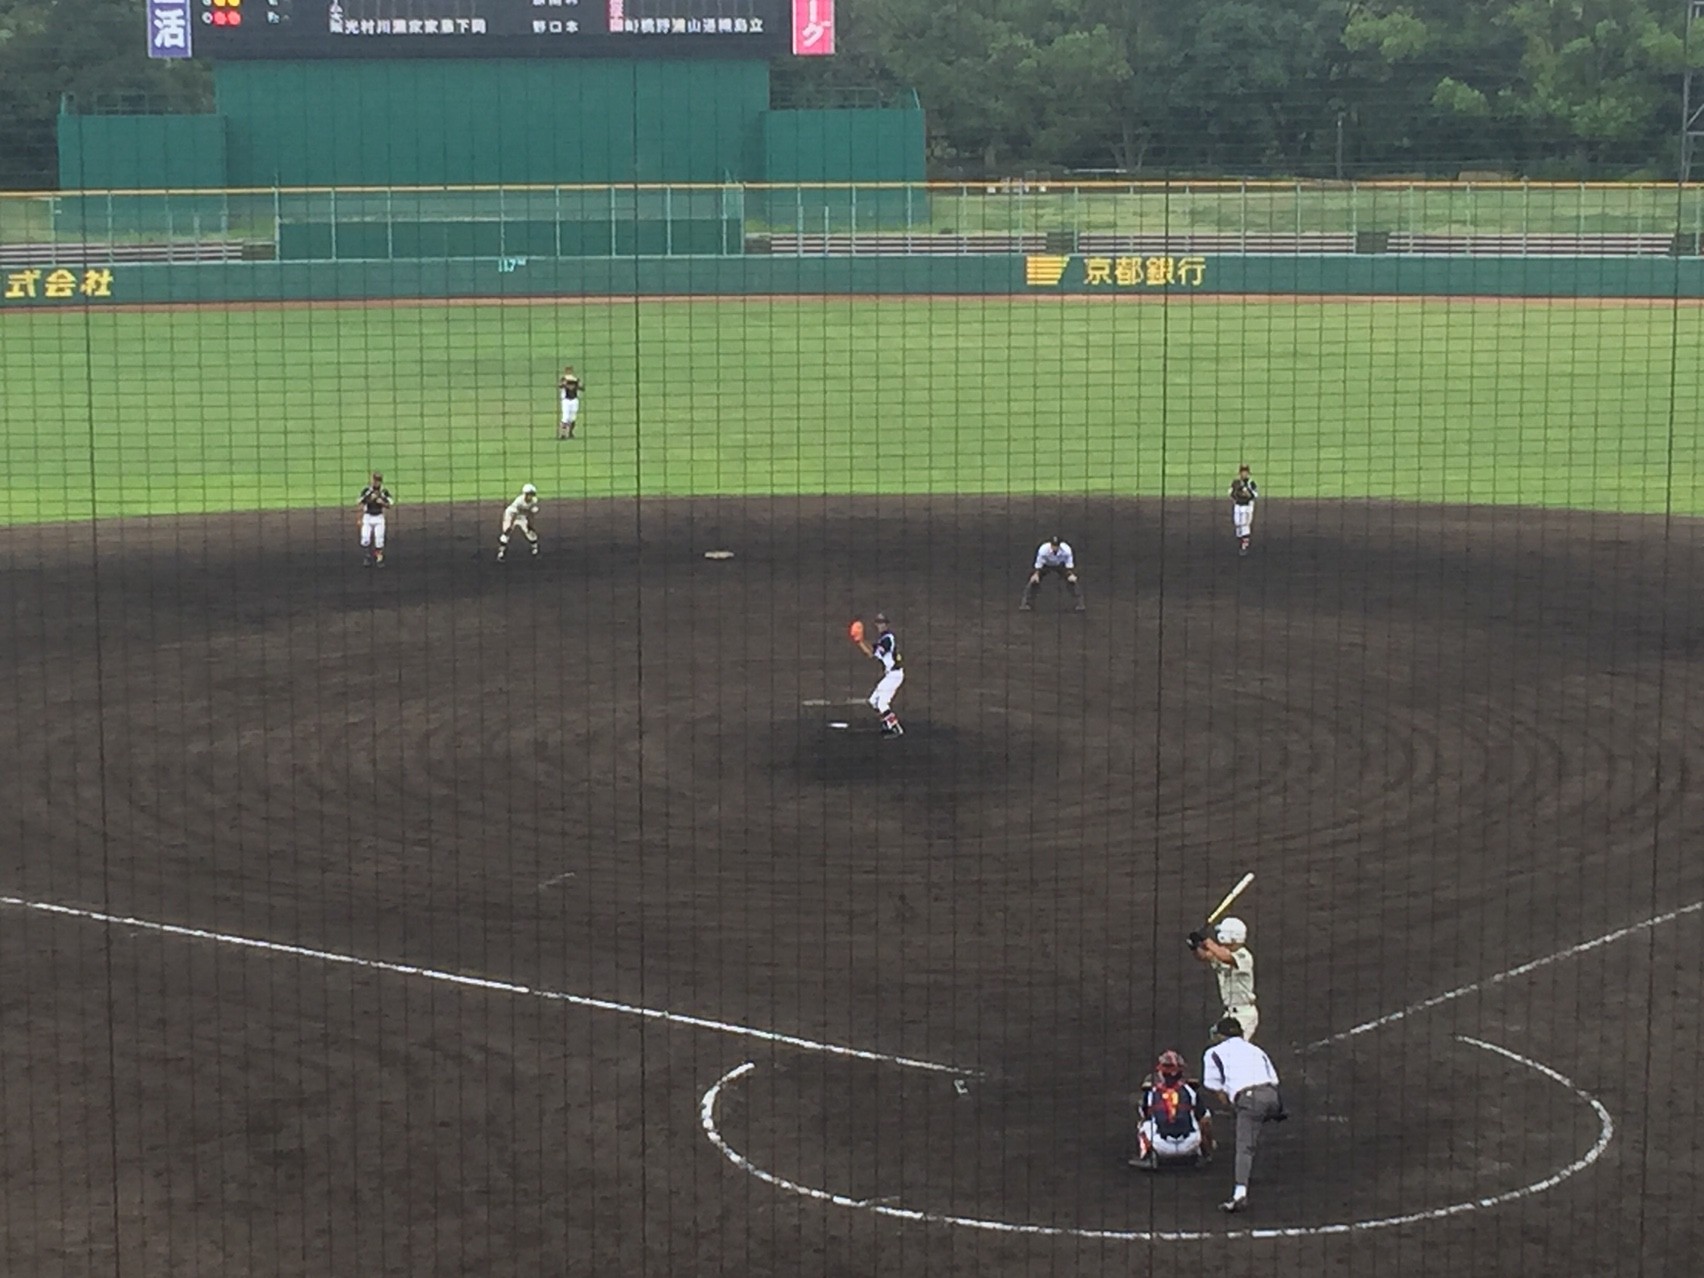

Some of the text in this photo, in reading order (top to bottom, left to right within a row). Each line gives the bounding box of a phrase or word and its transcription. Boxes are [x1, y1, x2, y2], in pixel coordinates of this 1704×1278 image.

[153, 0, 186, 48] 活
[4, 268, 114, 298] 式会社
[1083, 256, 1206, 286] 京都銀行
